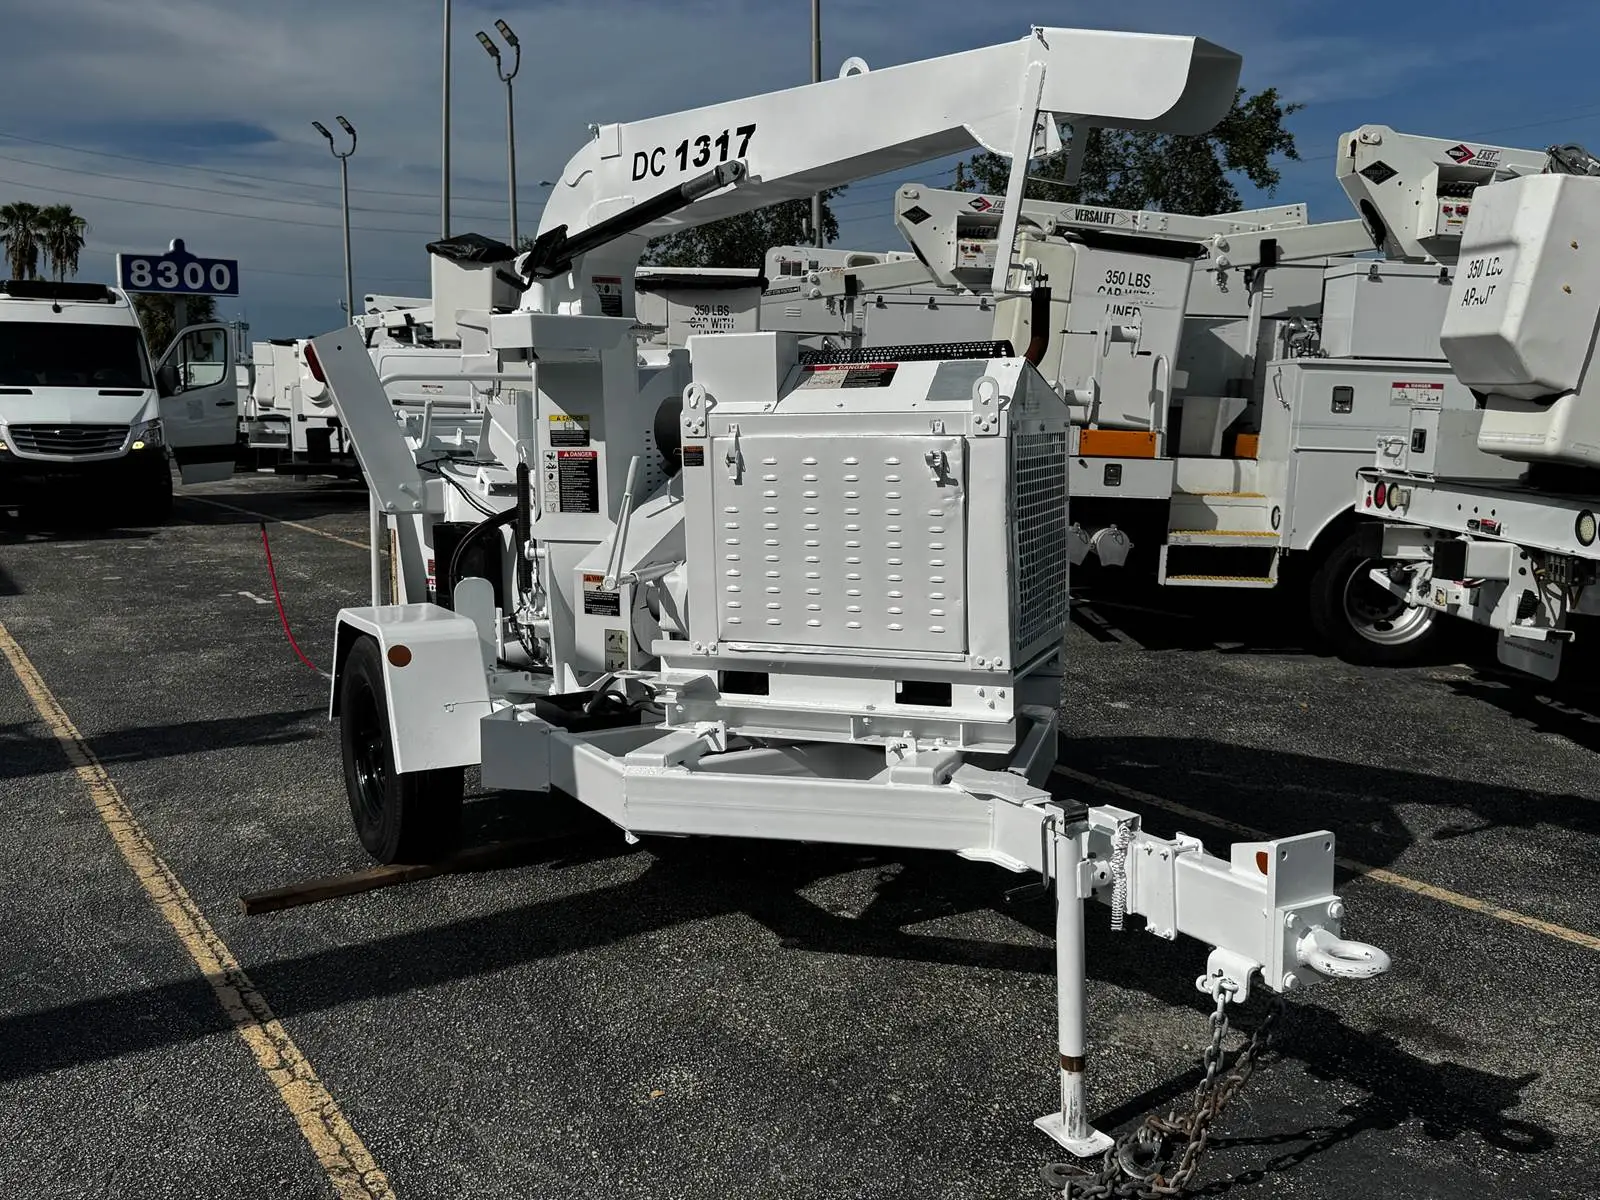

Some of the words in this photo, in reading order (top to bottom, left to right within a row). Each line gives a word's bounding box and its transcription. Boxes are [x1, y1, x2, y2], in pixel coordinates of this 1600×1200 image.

[631, 146, 666, 181] DC
[675, 123, 757, 172] 1317
[1075, 208, 1117, 225] VERSALIFT
[130, 259, 231, 291] 8300
[1105, 269, 1126, 285] 350
[1128, 272, 1151, 288] LBS
[1467, 258, 1484, 279] 350
[694, 304, 710, 316] 350
[712, 304, 730, 316] LBS
